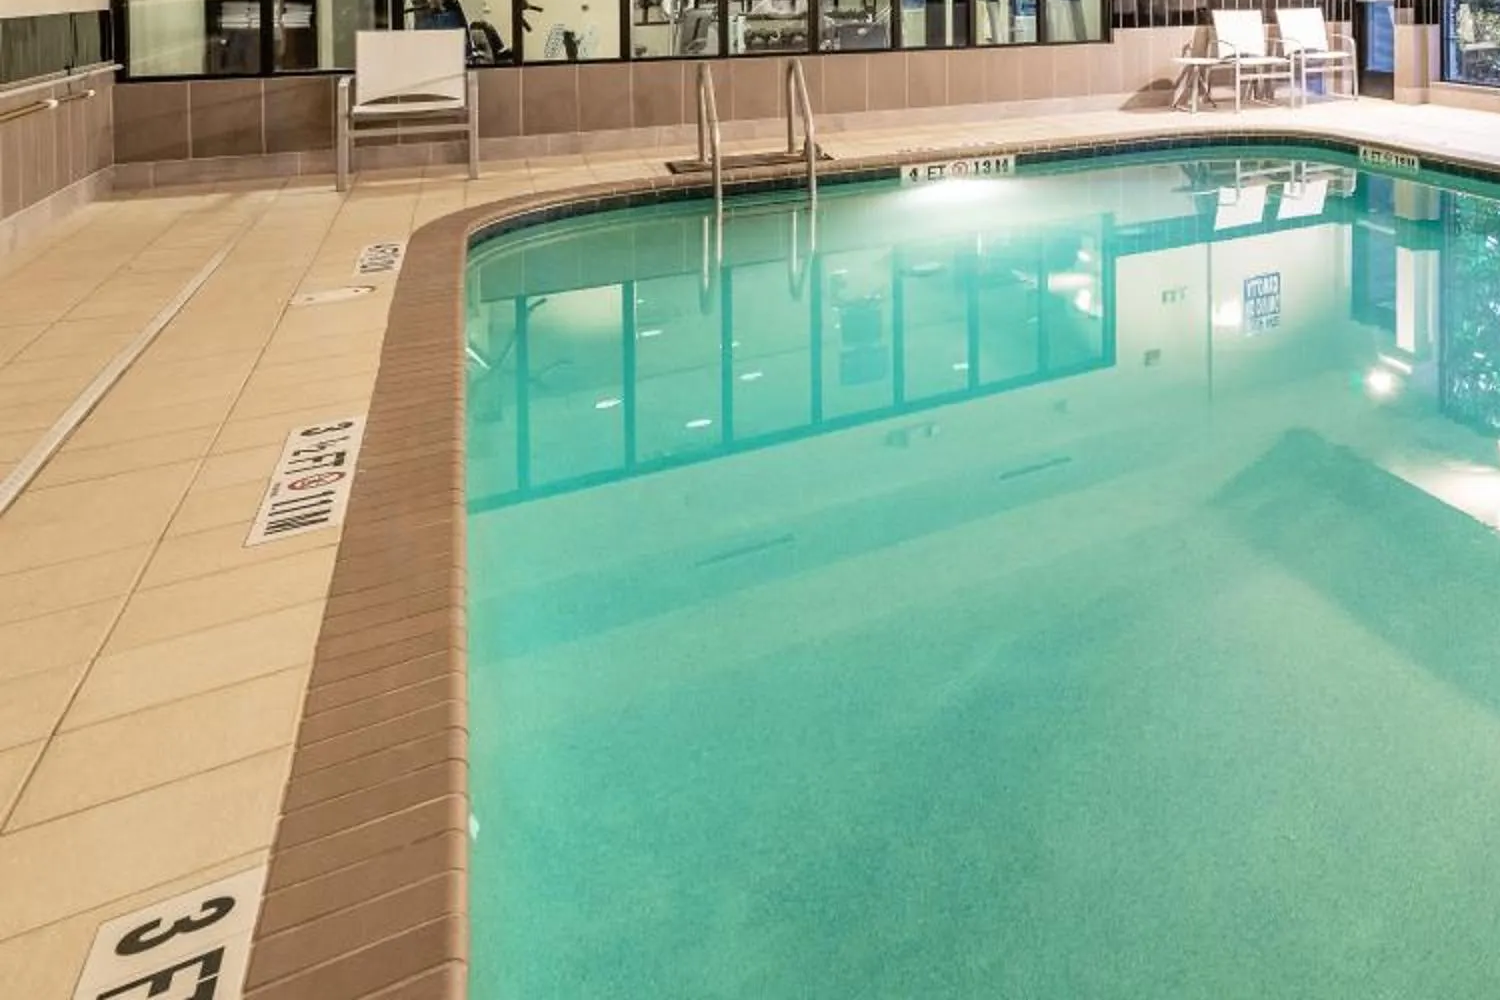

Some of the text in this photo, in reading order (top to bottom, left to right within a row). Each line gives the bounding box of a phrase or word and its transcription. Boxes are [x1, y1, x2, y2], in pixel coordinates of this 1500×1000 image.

[300, 421, 354, 436] 3
[284, 451, 347, 475] FT
[115, 896, 236, 956] 3
